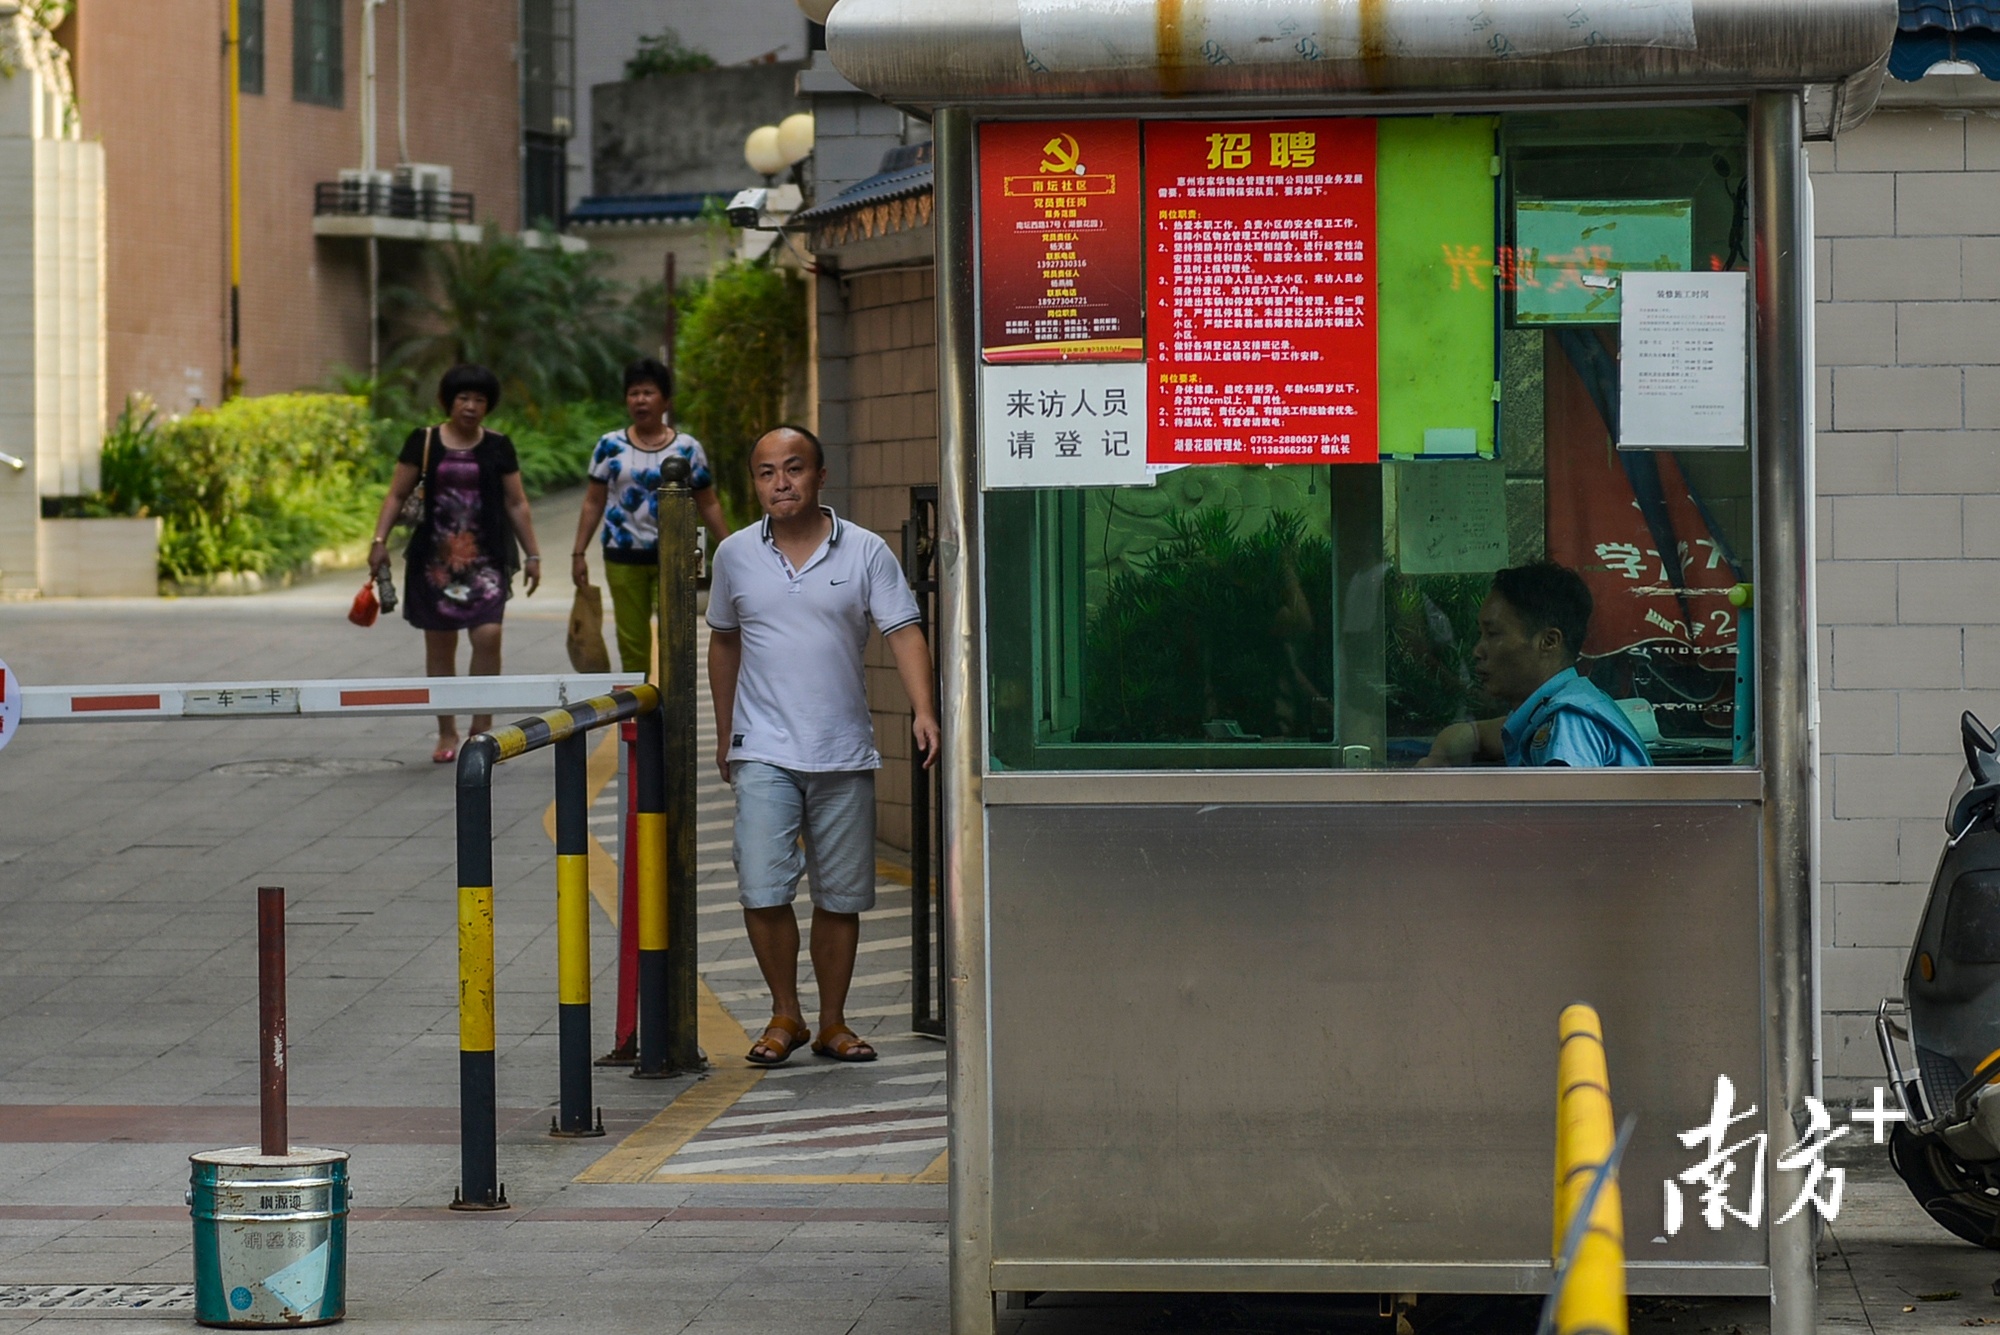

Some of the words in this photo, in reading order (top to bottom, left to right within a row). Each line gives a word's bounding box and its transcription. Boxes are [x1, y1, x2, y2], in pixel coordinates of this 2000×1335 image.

[1206, 131, 1316, 170] 招聘
[1032, 180, 1088, 192] 南坛社区
[1034, 197, 1087, 208] 党员责任岗
[1159, 210, 1201, 219] 岗位职责：
[1042, 233, 1079, 242] 党员责任人
[1046, 252, 1076, 260] 联系电话
[1042, 270, 1080, 279] 党员责任人
[1046, 288, 1077, 297] 联系电话
[1173, 330, 1198, 340] 小区。
[1159, 374, 1203, 384] 岗位要求：
[1006, 388, 1129, 418] 来访人员
[1007, 430, 1130, 459] 请登记
[1174, 438, 1247, 452] 湖景花园管理处：
[193, 688, 282, 707] 一车一卡
